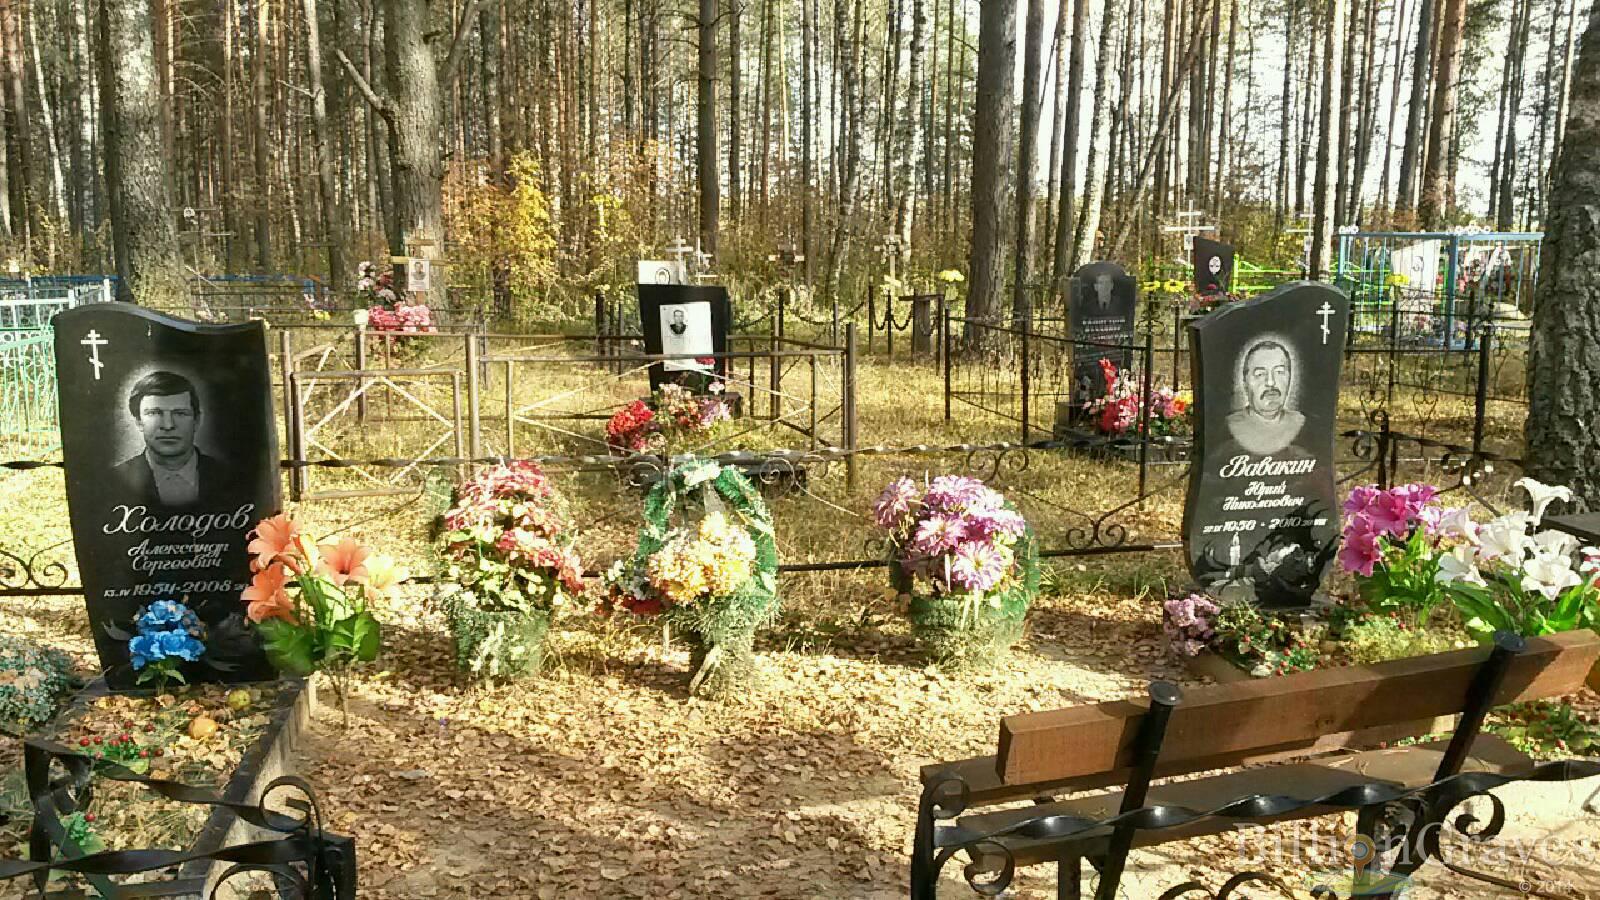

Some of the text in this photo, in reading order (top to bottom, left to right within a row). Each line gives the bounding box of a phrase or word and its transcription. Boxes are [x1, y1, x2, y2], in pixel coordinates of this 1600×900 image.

[1219, 454, 1317, 478] Вавакин
[1244, 480, 1287, 501] Юрий
[102, 504, 255, 538] Холодов
[127, 538, 230, 557] Александр
[132, 554, 222, 577] Сергеевич
